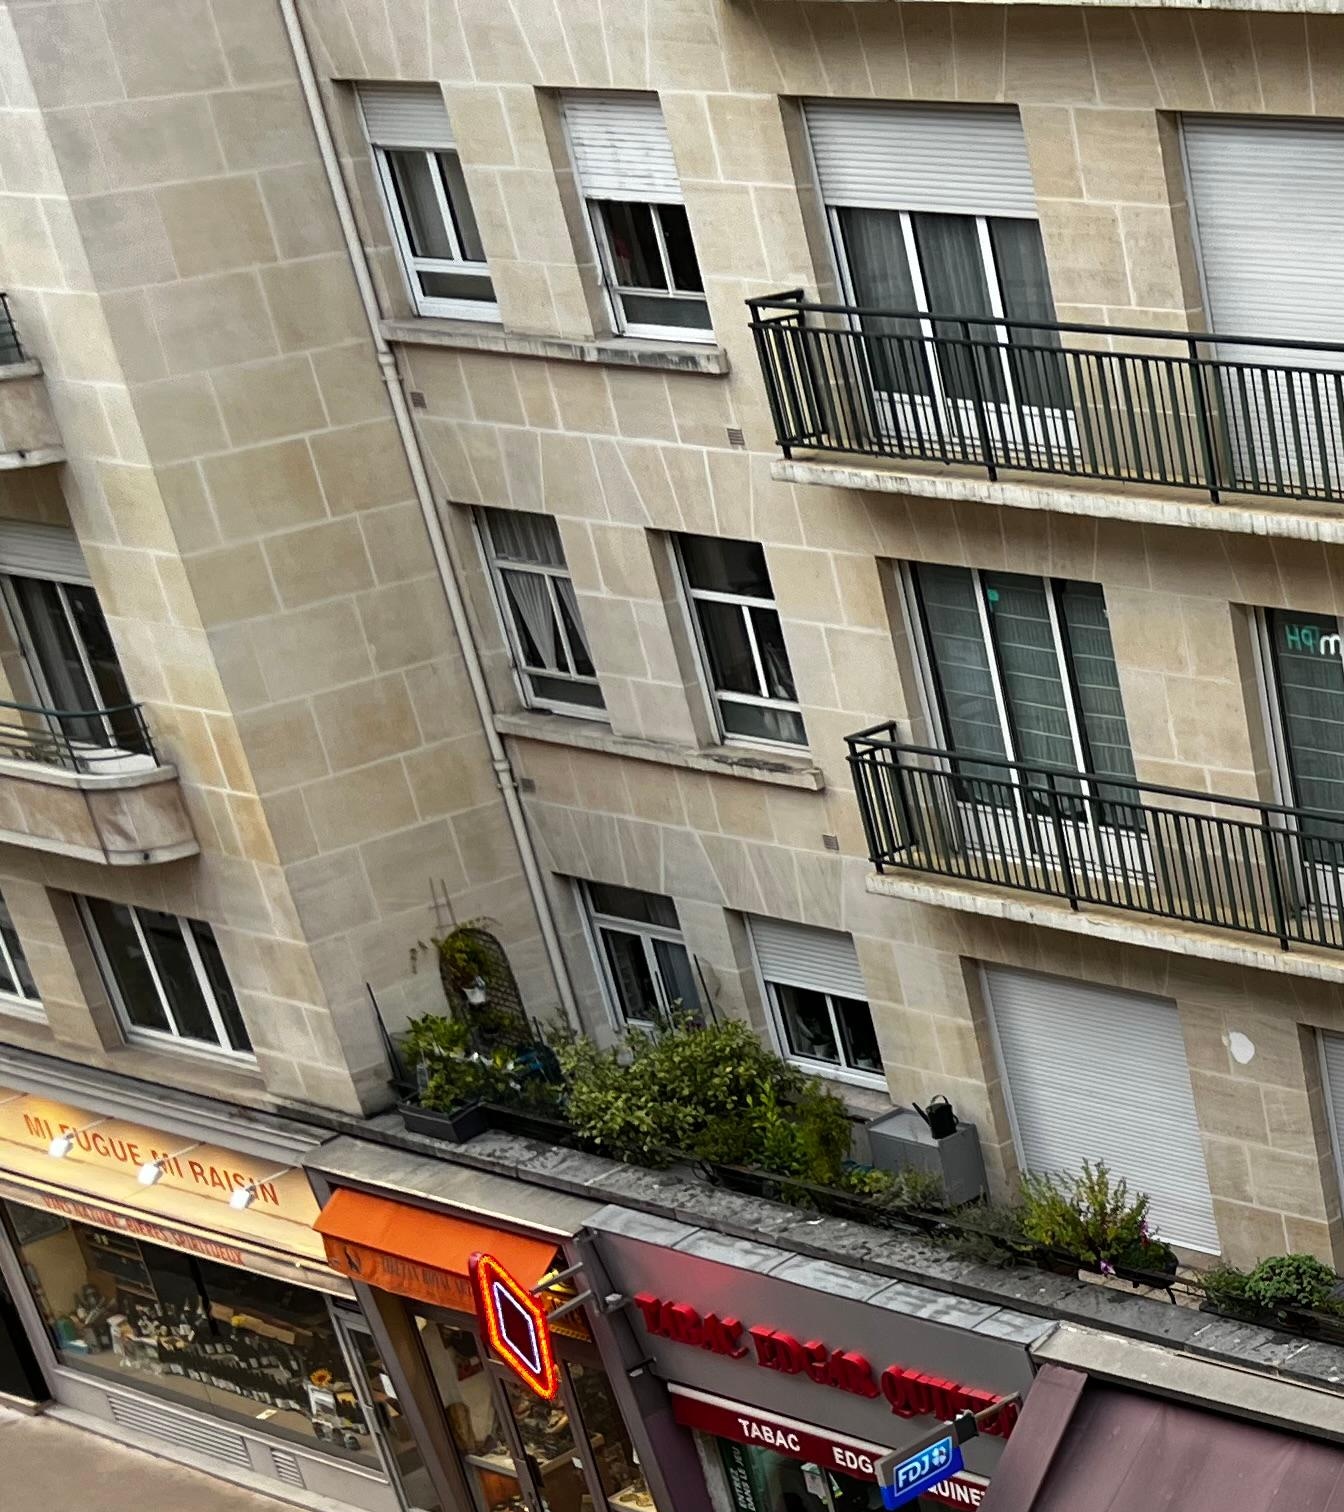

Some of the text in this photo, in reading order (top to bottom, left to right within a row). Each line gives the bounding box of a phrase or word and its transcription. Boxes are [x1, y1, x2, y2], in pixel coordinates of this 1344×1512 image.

[23, 1113, 281, 1206] MI FUGUE MI RAISIN
[634, 1290, 750, 1360] TABAC
[748, 1324, 882, 1400] EDGAR
[737, 1417, 986, 1507] TABAC EDG UINE
[897, 1453, 930, 1488] FDJ
